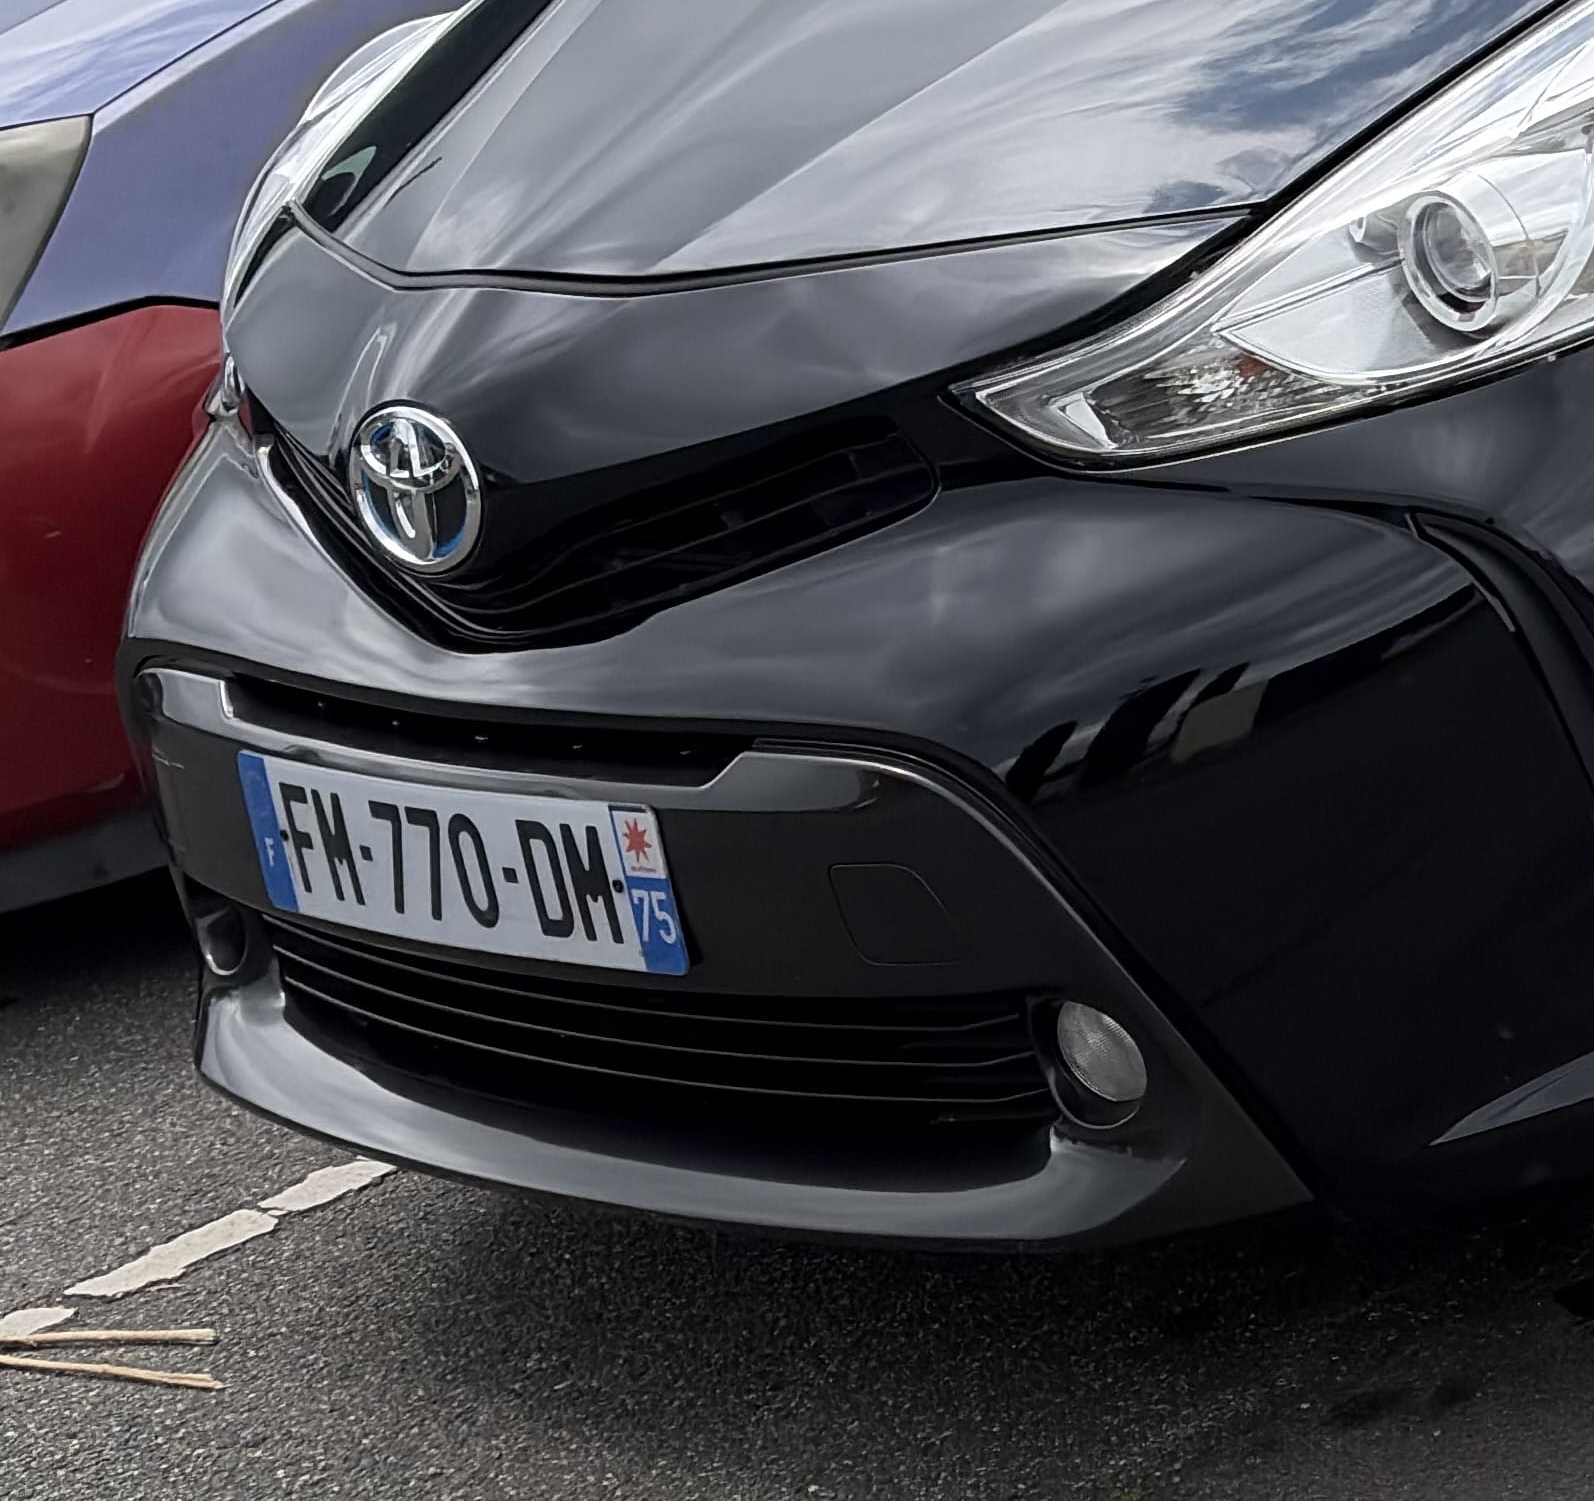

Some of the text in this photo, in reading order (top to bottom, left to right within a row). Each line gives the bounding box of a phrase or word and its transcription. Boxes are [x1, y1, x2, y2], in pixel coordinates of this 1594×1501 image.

[263, 837, 276, 869] F
[279, 782, 625, 945] FM-770-DM
[631, 889, 678, 945] 75
